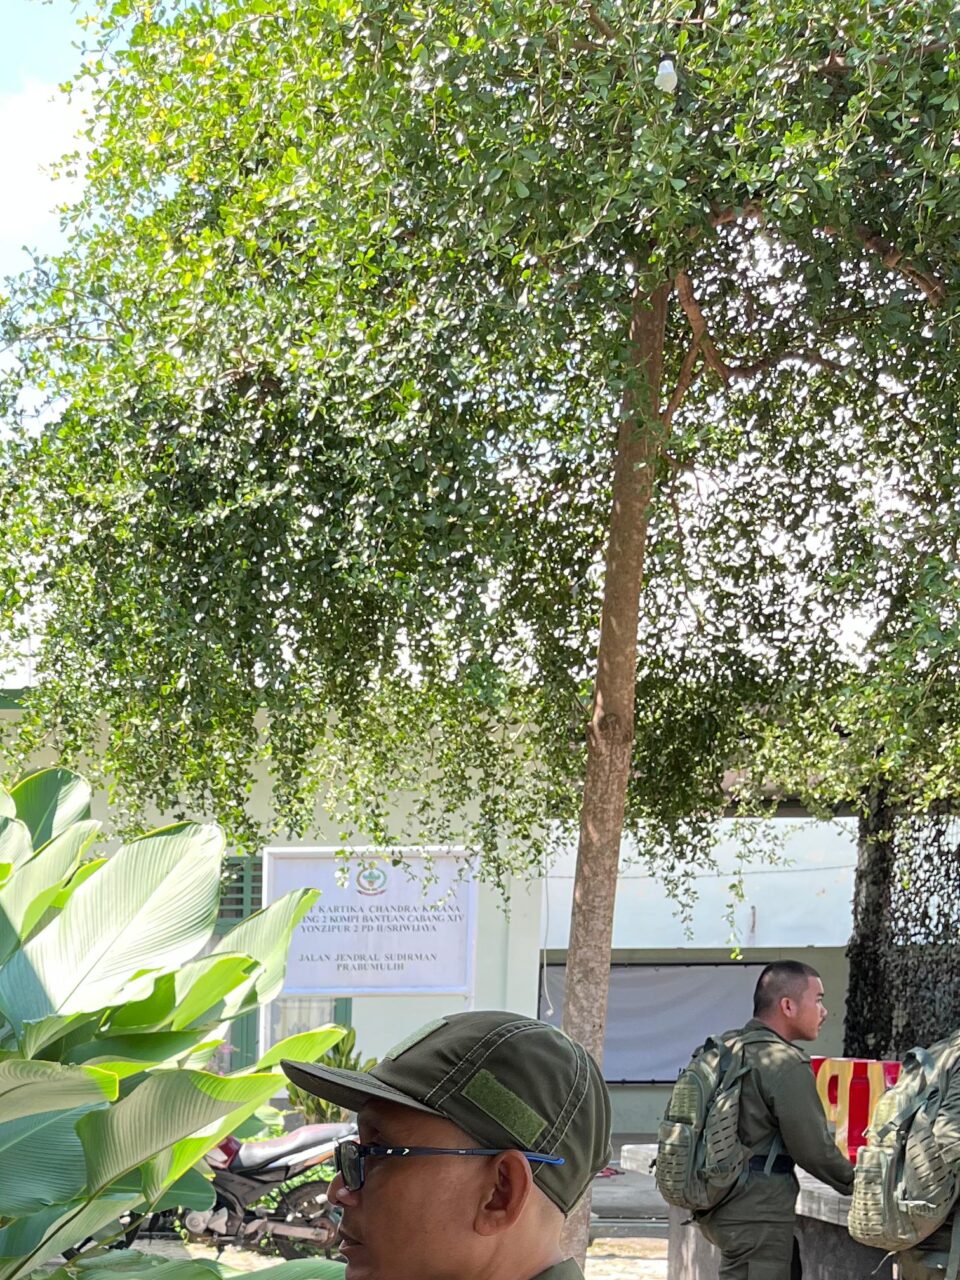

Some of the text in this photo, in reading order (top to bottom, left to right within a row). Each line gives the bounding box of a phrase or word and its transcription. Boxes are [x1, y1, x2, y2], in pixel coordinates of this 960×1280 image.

[319, 905, 364, 913] KARTIKA
[369, 904, 416, 913] CHANDRA
[330, 915, 359, 923] KOMPI
[363, 914, 406, 923] BANTUAN
[407, 914, 444, 923] CABANG
[448, 914, 464, 922] XIV
[301, 925, 350, 933] YONZIPUR
[362, 925, 374, 933] PD
[299, 953, 437, 962] JALAN JENDRAL SUDIRMAN
[337, 963, 404, 971] PRABUMULIH
